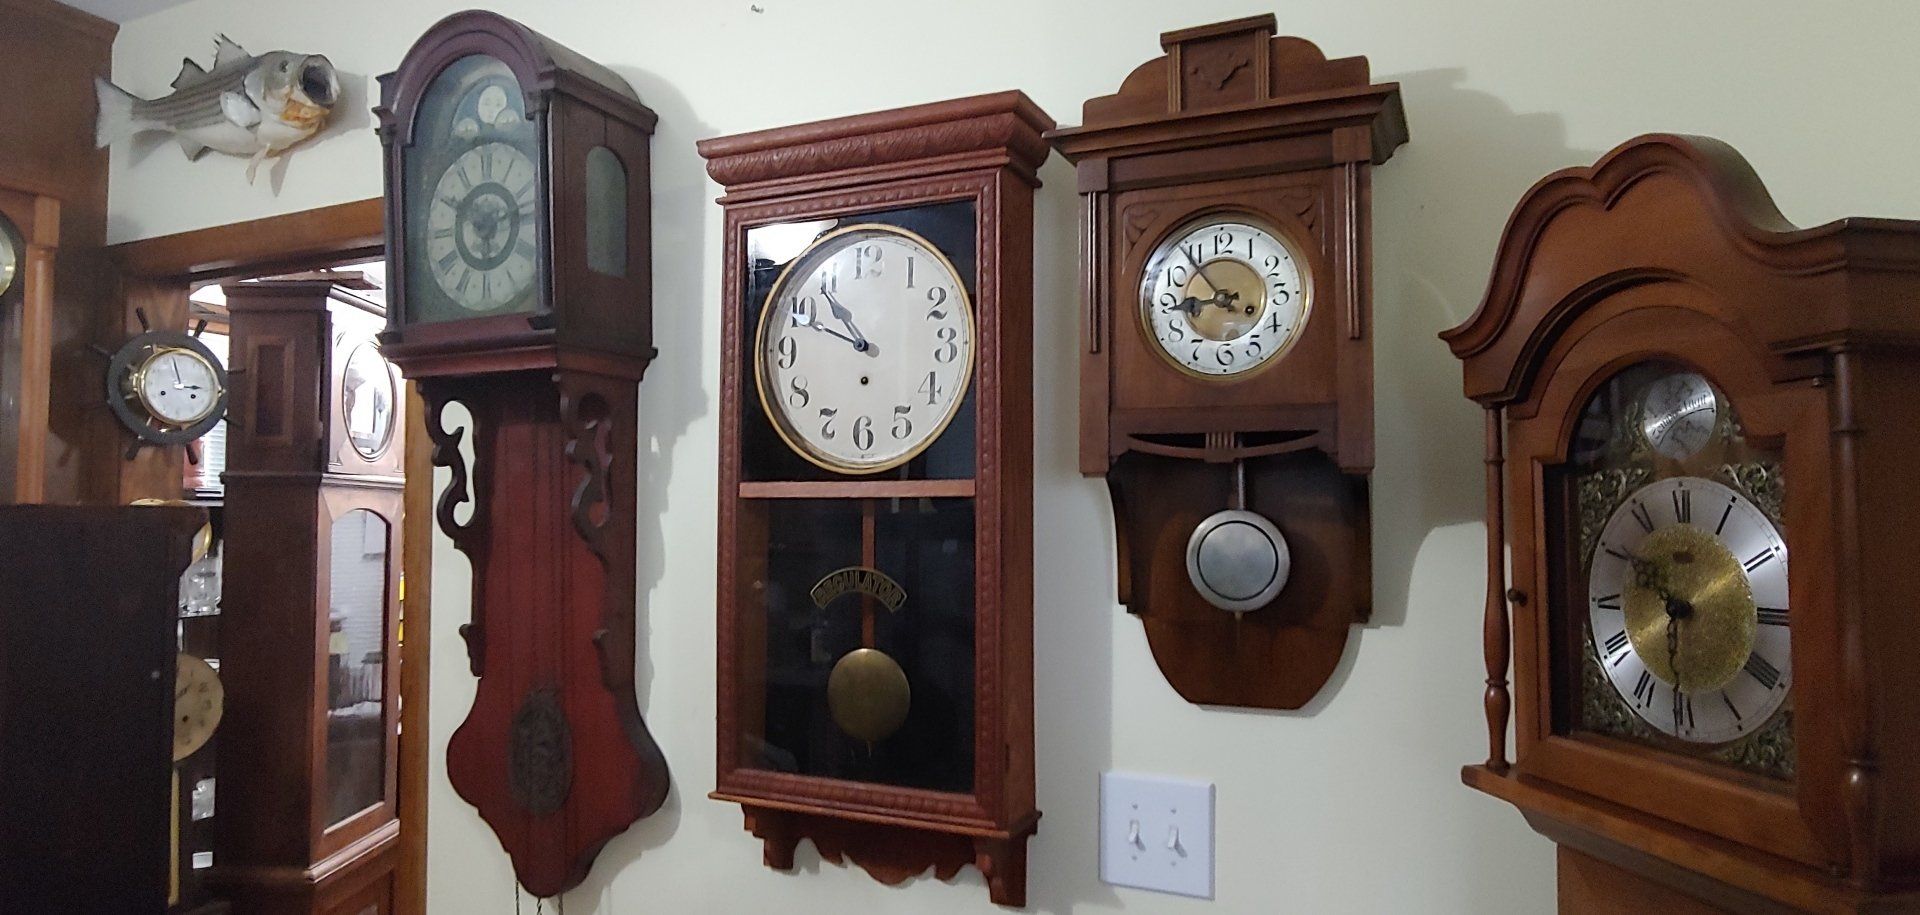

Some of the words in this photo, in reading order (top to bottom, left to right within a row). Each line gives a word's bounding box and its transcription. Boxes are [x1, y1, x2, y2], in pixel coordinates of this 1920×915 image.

[1214, 232, 1234, 255] 12
[1248, 238, 1253, 260] 1
[854, 245, 884, 280] 12
[906, 256, 916, 289] 1
[1167, 265, 1187, 288] 10
[1264, 255, 1279, 278] 2
[927, 286, 948, 320] 2
[1159, 292, 1177, 315] 9
[1272, 282, 1290, 306] 3
[791, 296, 817, 328] 10
[1262, 312, 1282, 334] 4
[934, 327, 958, 364] 3
[1168, 318, 1184, 342] 8
[1246, 334, 1262, 358] 5
[778, 336, 797, 369] 9
[1191, 338, 1204, 361] 7
[1216, 343, 1234, 366] 6
[789, 375, 810, 409] 8
[917, 371, 942, 405] 4
[819, 408, 838, 440] 7
[852, 416, 874, 450] 6
[891, 404, 912, 440] 5
[1715, 504, 1732, 536] I
[1743, 547, 1775, 573] II
[813, 570, 902, 608] REGULATOR
